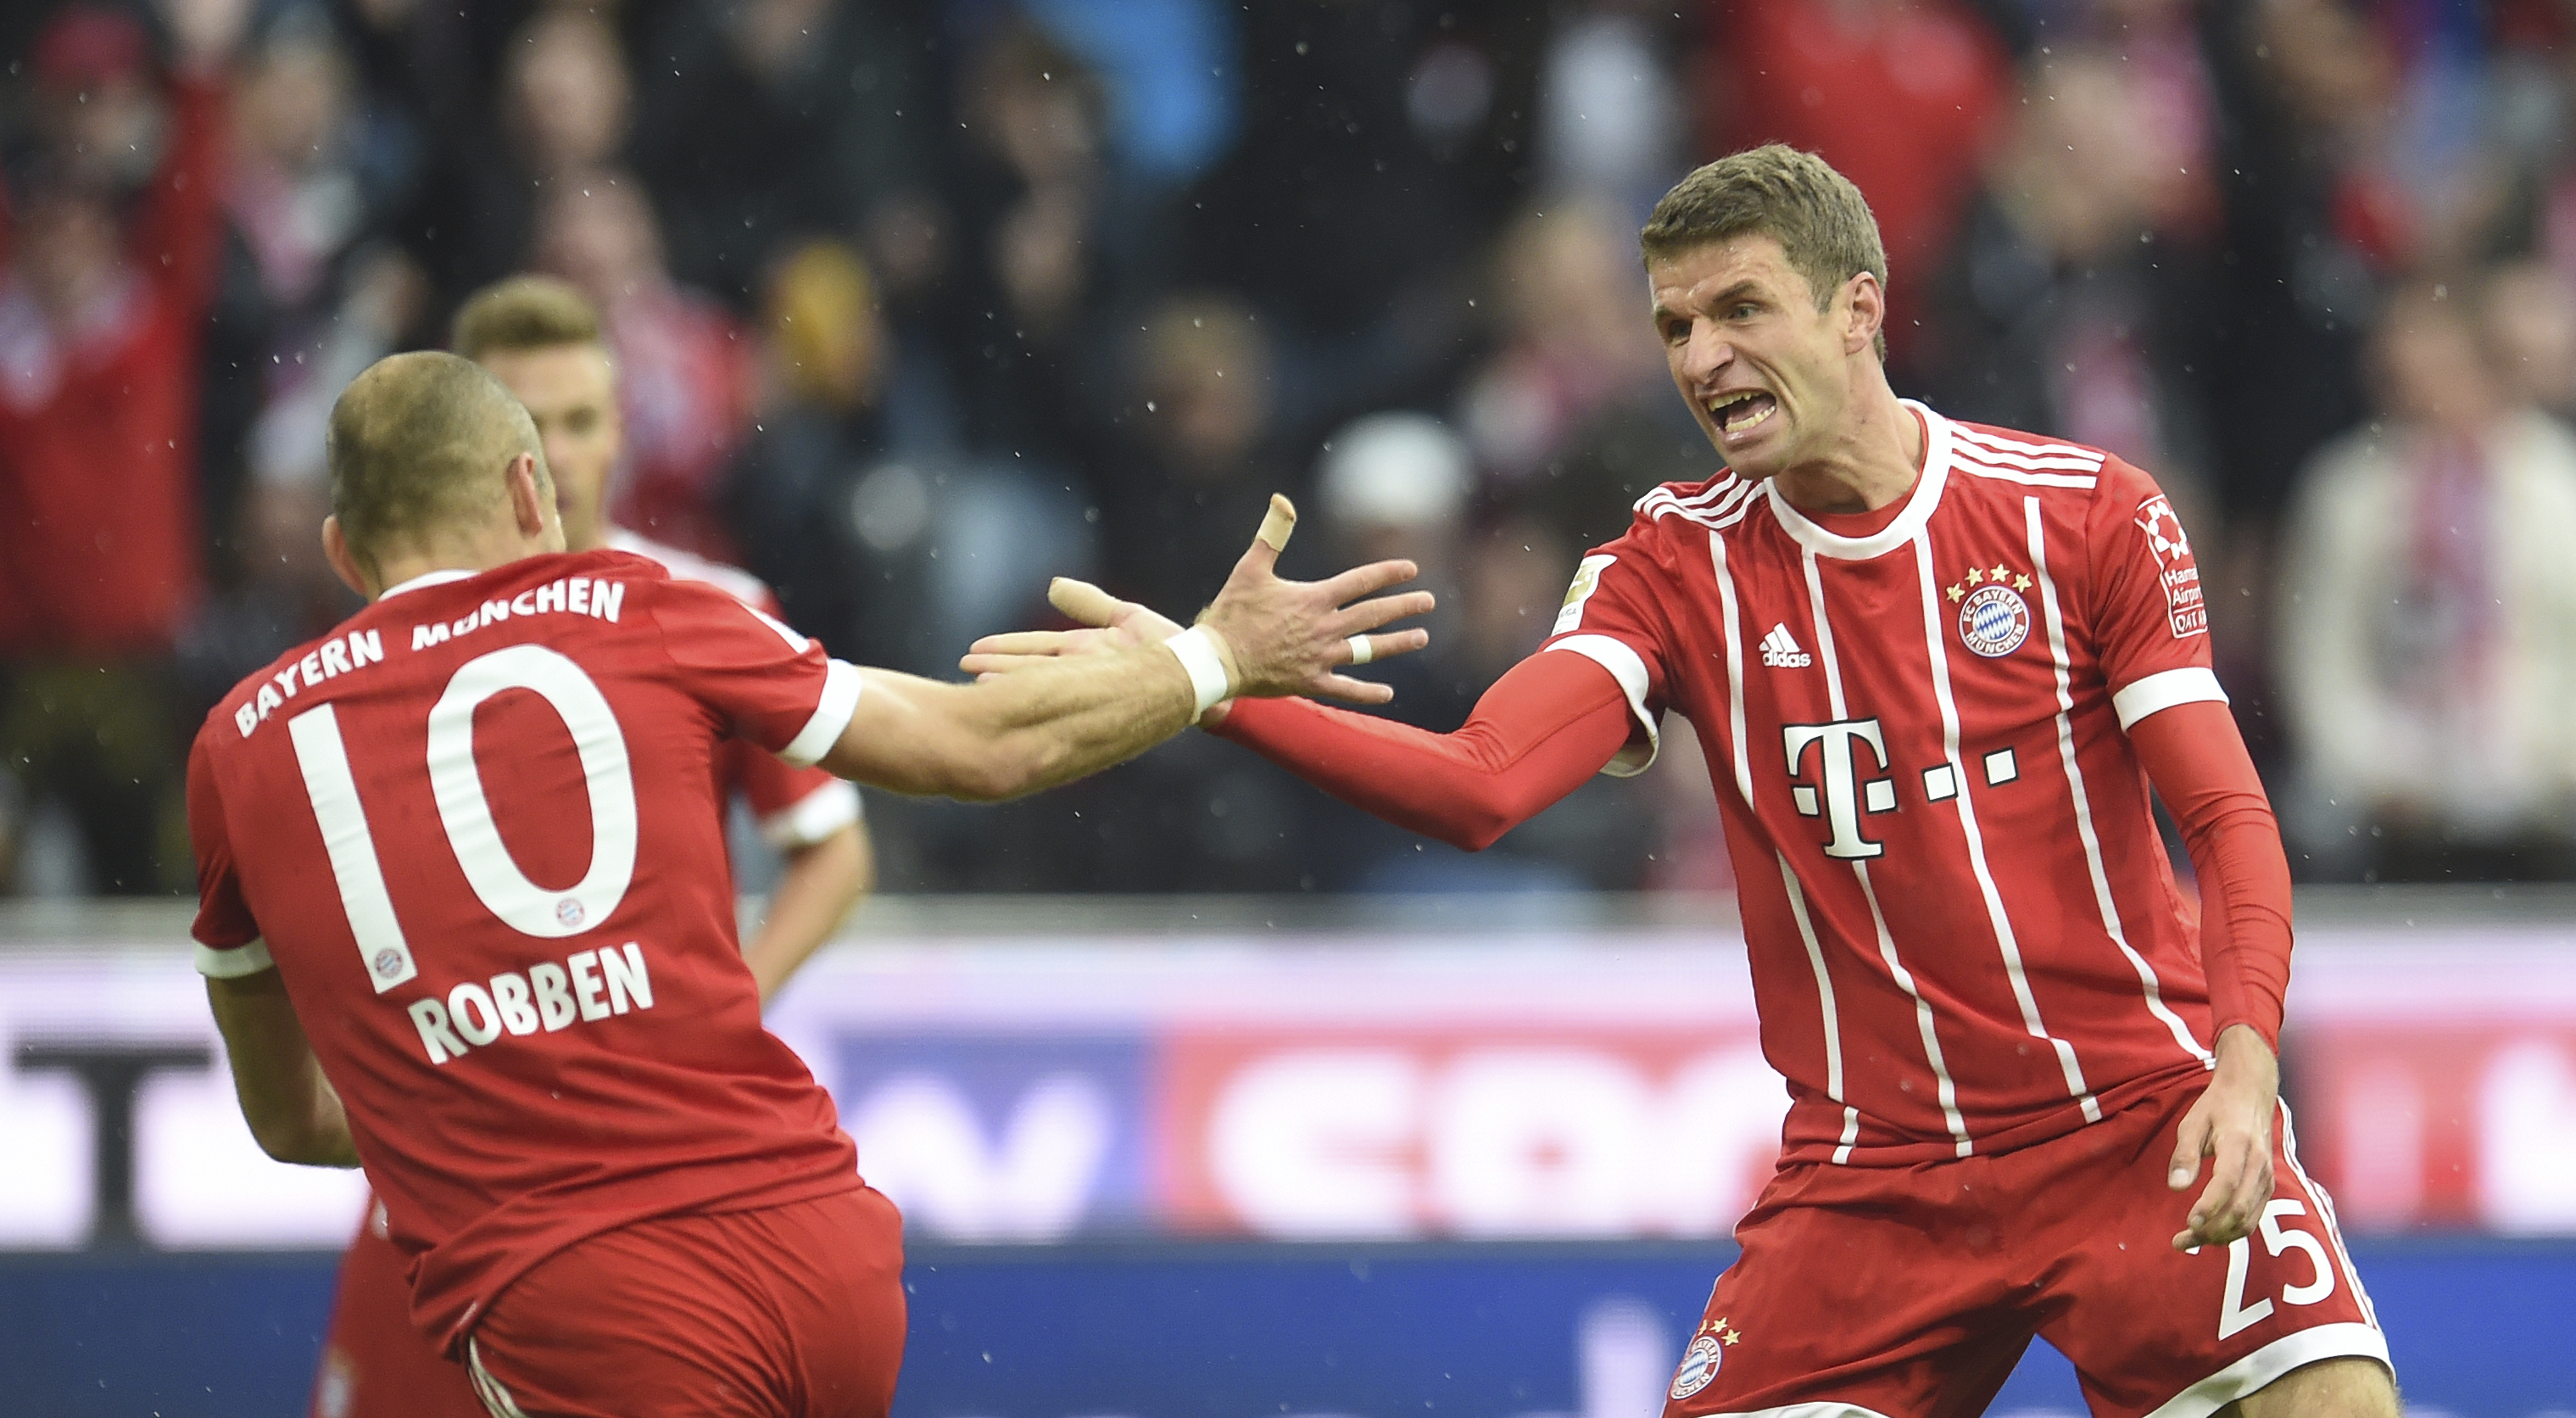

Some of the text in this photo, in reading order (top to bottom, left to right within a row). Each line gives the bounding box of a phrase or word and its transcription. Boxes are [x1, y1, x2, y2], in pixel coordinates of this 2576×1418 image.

[1762, 650, 1812, 667] adidas
[1963, 590, 2023, 622] FC BAYERN
[235, 628, 384, 738] BAYERN
[287, 643, 638, 995] 10
[407, 941, 654, 1065] ROBBEN
[2185, 1197, 2335, 1342] 25
